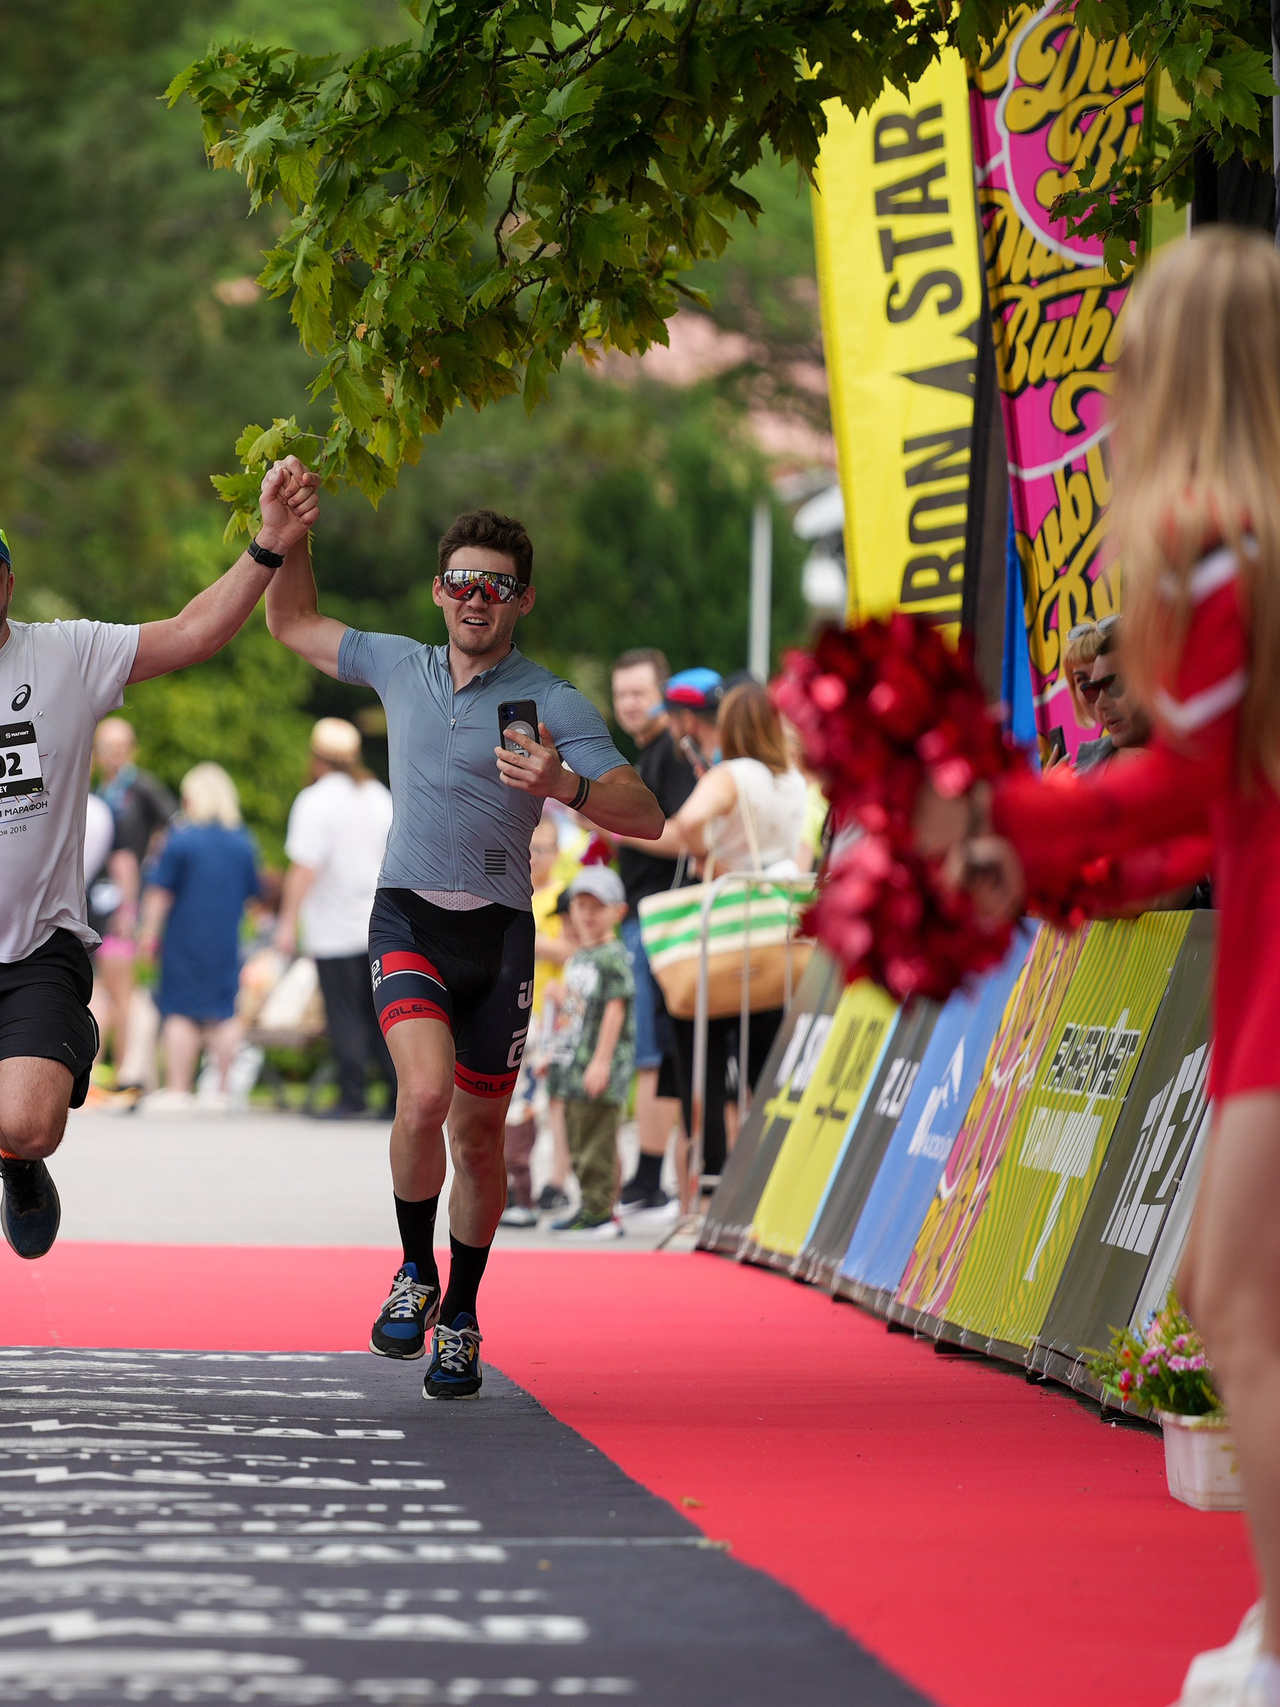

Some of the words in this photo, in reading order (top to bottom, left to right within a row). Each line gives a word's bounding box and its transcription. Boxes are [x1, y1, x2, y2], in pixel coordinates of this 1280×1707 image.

[874, 101, 964, 323] STAR
[4, 800, 48, 817] МАРАФОН
[9, 825, 27, 835] 2018
